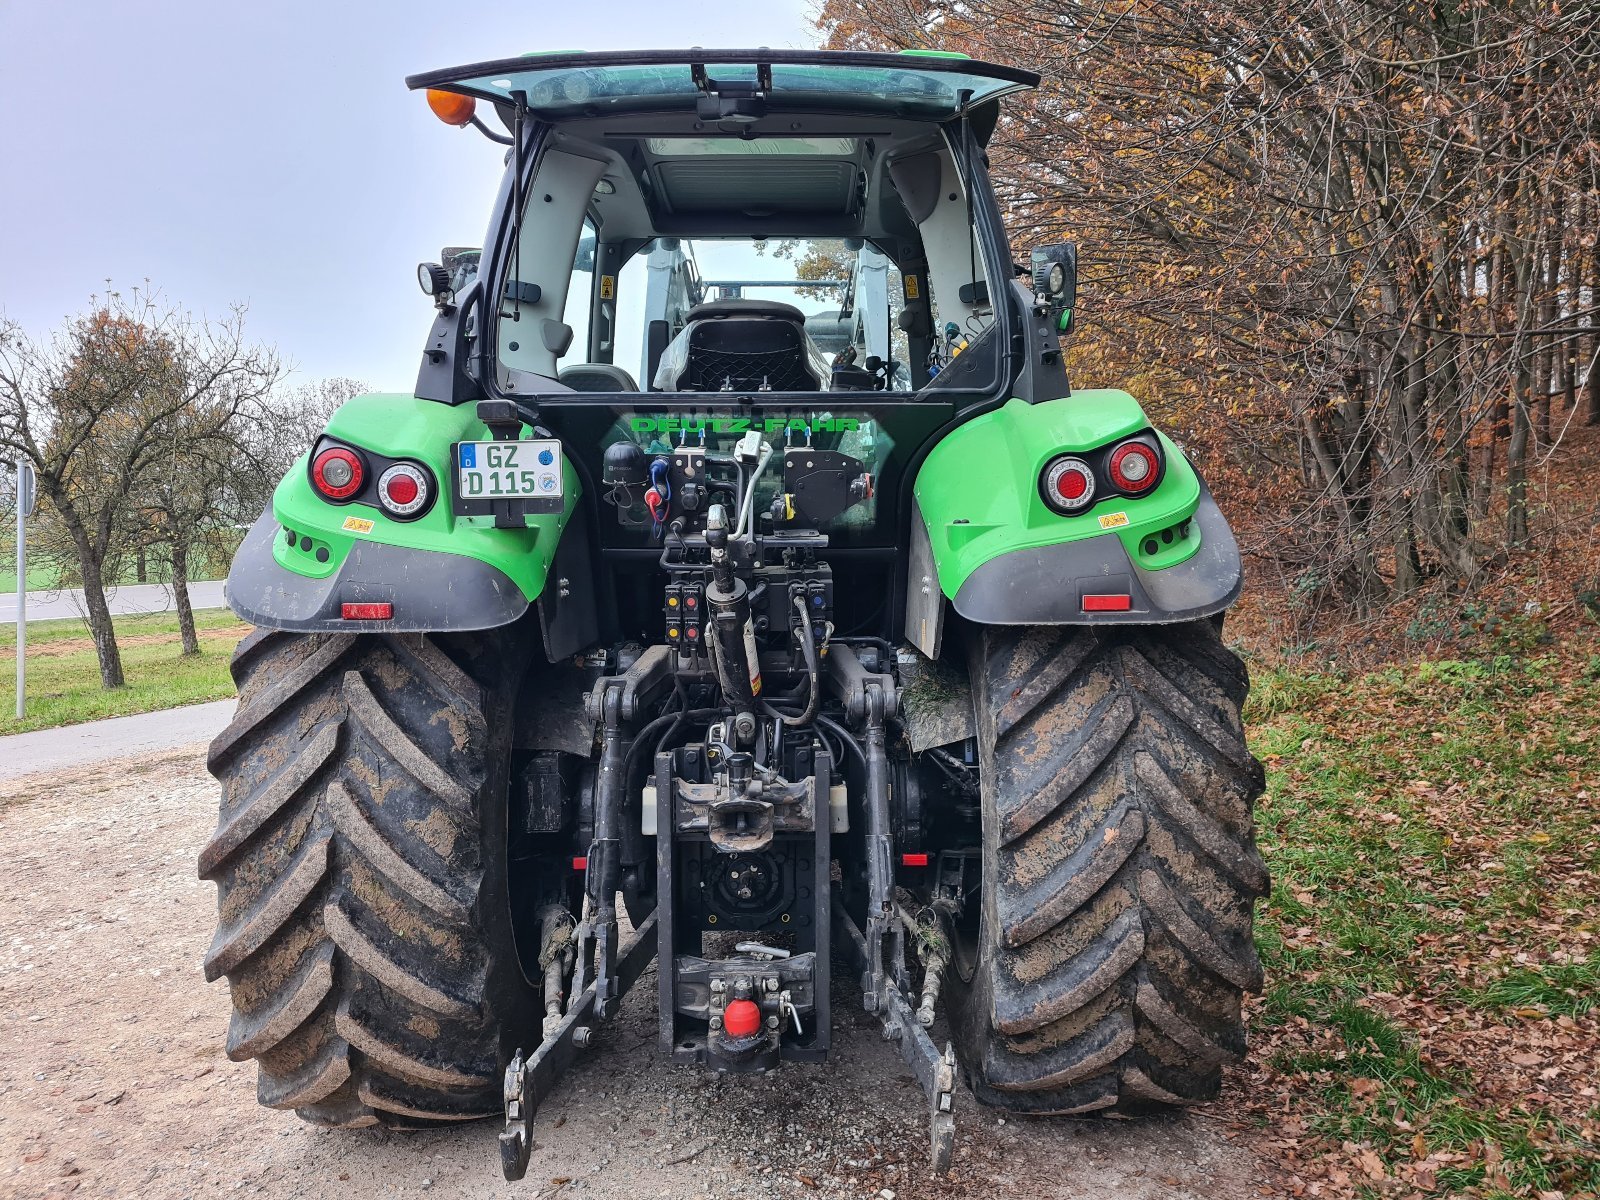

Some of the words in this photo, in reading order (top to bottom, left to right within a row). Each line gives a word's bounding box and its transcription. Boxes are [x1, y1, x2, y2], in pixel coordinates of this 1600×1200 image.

[629, 418, 859, 433] DEUTZ-FAHR
[465, 459, 471, 467] D
[486, 445, 519, 468] GZ
[468, 472, 482, 494] D
[489, 471, 535, 494] 115
